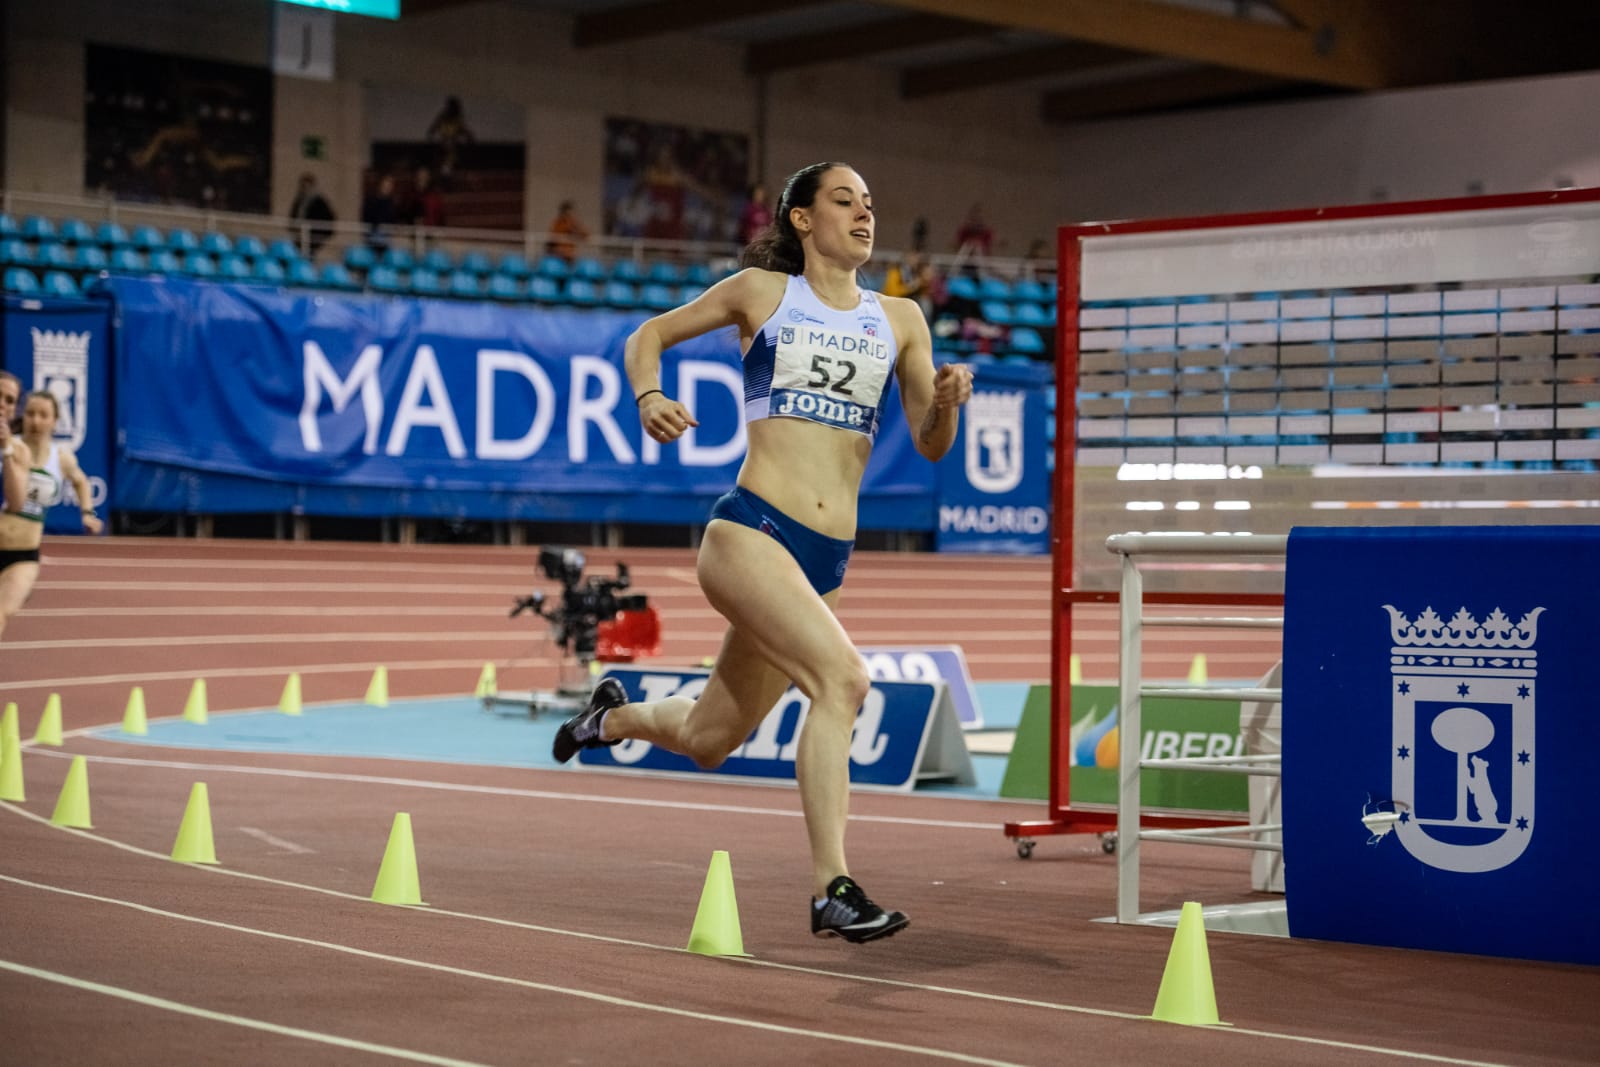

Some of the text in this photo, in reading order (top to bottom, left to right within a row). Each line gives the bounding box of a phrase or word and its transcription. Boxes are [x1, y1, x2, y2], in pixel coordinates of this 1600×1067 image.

[808, 331, 888, 360] MADRID
[807, 354, 857, 396] 52
[938, 504, 1048, 533] MADRID
